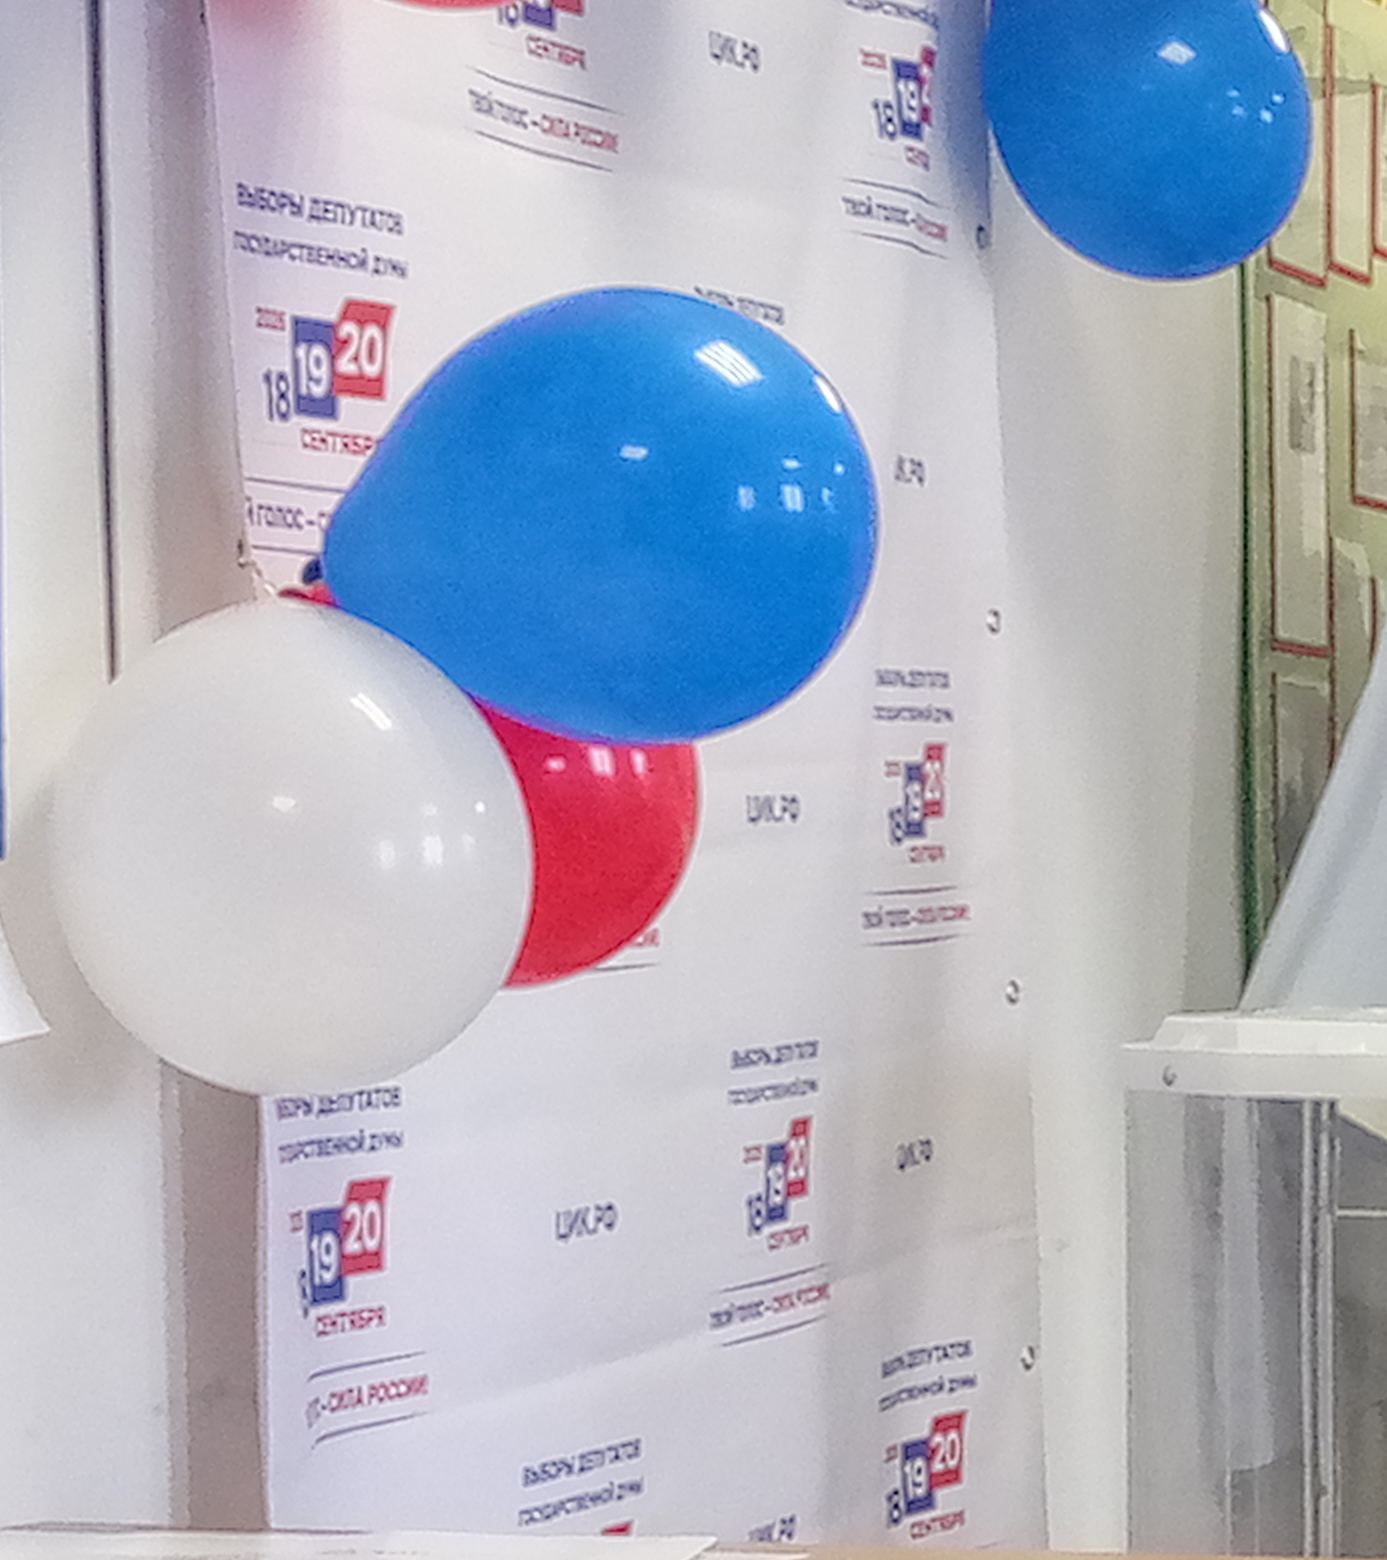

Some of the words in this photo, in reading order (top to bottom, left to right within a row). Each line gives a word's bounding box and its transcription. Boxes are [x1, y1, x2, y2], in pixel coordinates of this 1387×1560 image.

[307, 197, 404, 237] ДЕПУТАТОВ
[264, 368, 291, 422] 18
[295, 341, 332, 399] 19
[338, 321, 385, 380] 20
[300, 427, 379, 457] СЕНТЯБР
[311, 1232, 341, 1288] 19
[344, 1200, 381, 1256] 20
[555, 1201, 619, 1244] ЦИК.РФ
[903, 1458, 929, 1500] 19
[929, 1432, 960, 1470] 20
